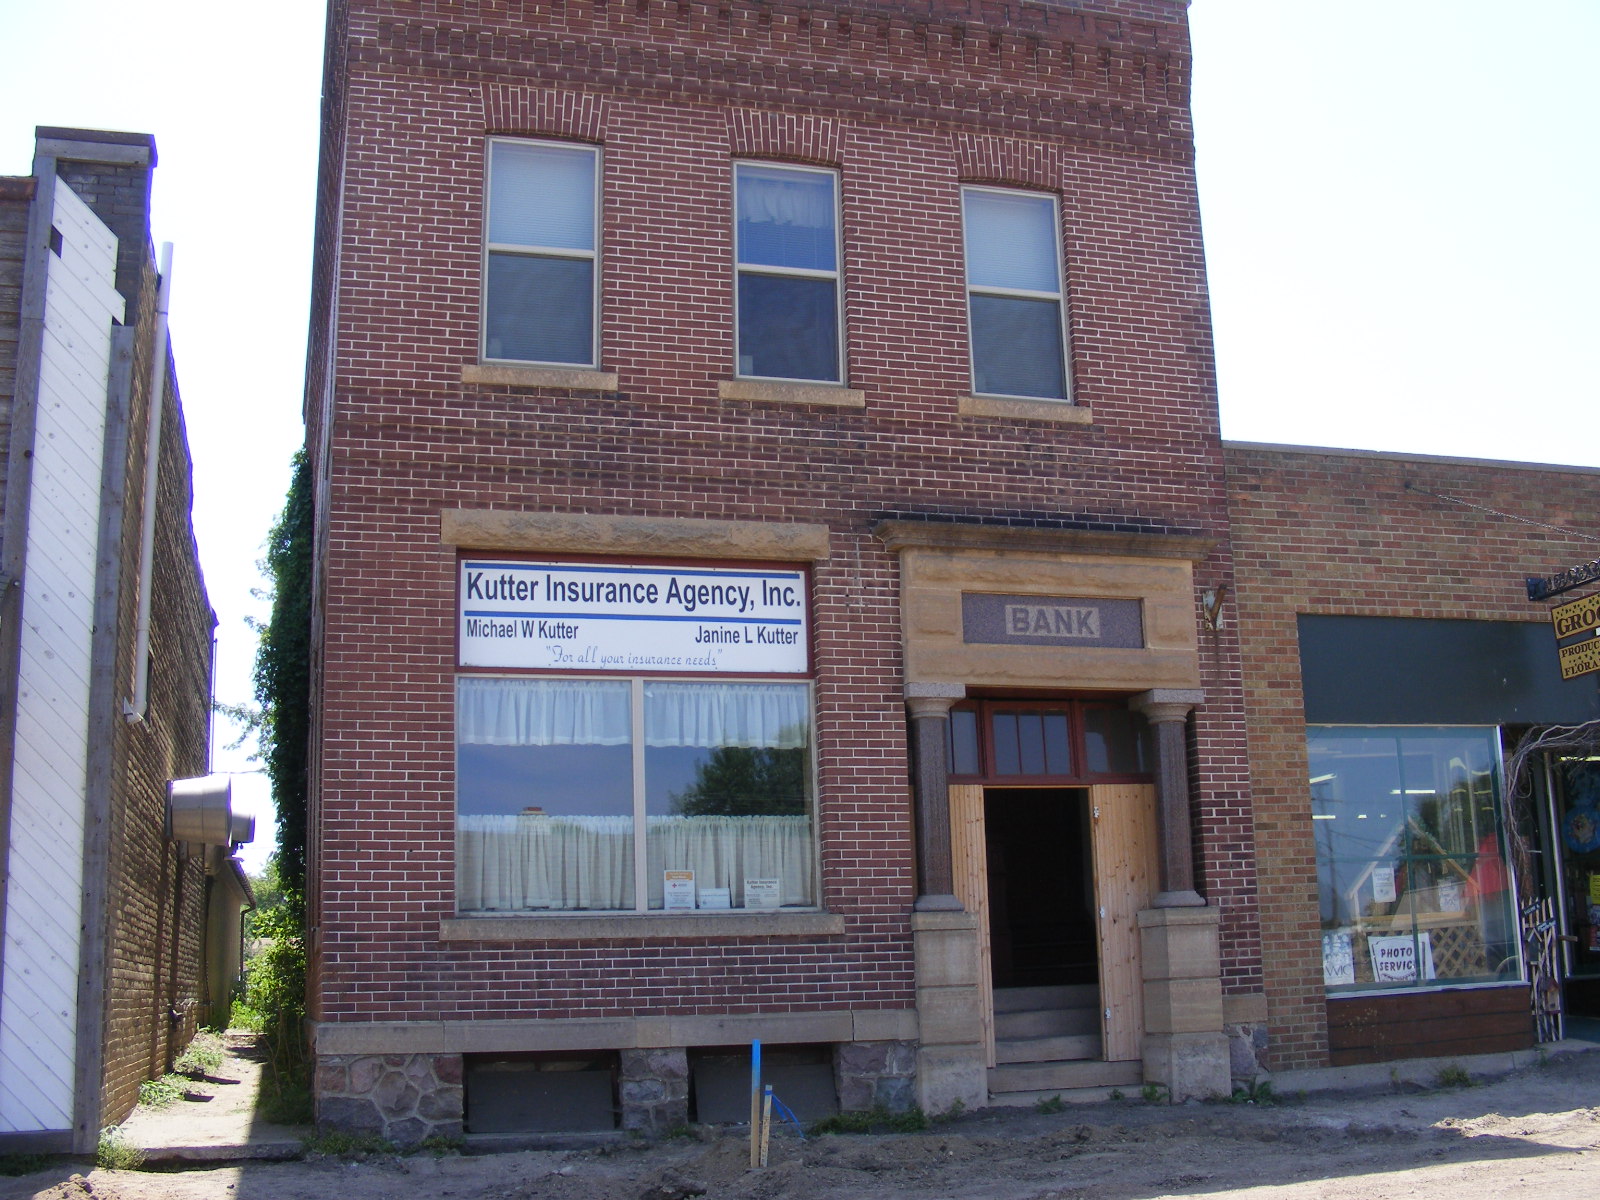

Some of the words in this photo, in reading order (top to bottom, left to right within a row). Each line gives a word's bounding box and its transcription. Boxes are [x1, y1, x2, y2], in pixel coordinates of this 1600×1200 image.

[467, 572, 538, 600] Kutter
[546, 574, 658, 603] Insurance
[666, 577, 755, 613] Agency,
[762, 580, 800, 607] Inc.
[466, 619, 517, 638] Michael
[521, 620, 534, 639] W
[538, 620, 578, 639] Kutter
[1012, 607, 1094, 635] BANK
[1557, 605, 1600, 636] GRO
[695, 625, 740, 644] Janine
[744, 626, 753, 644] L
[757, 626, 798, 645] Kutter
[577, 646, 598, 663] all
[601, 654, 625, 668] your
[628, 653, 682, 666] insurance
[1564, 658, 1600, 676] FLORA
[1381, 947, 1412, 958] PHOTO
